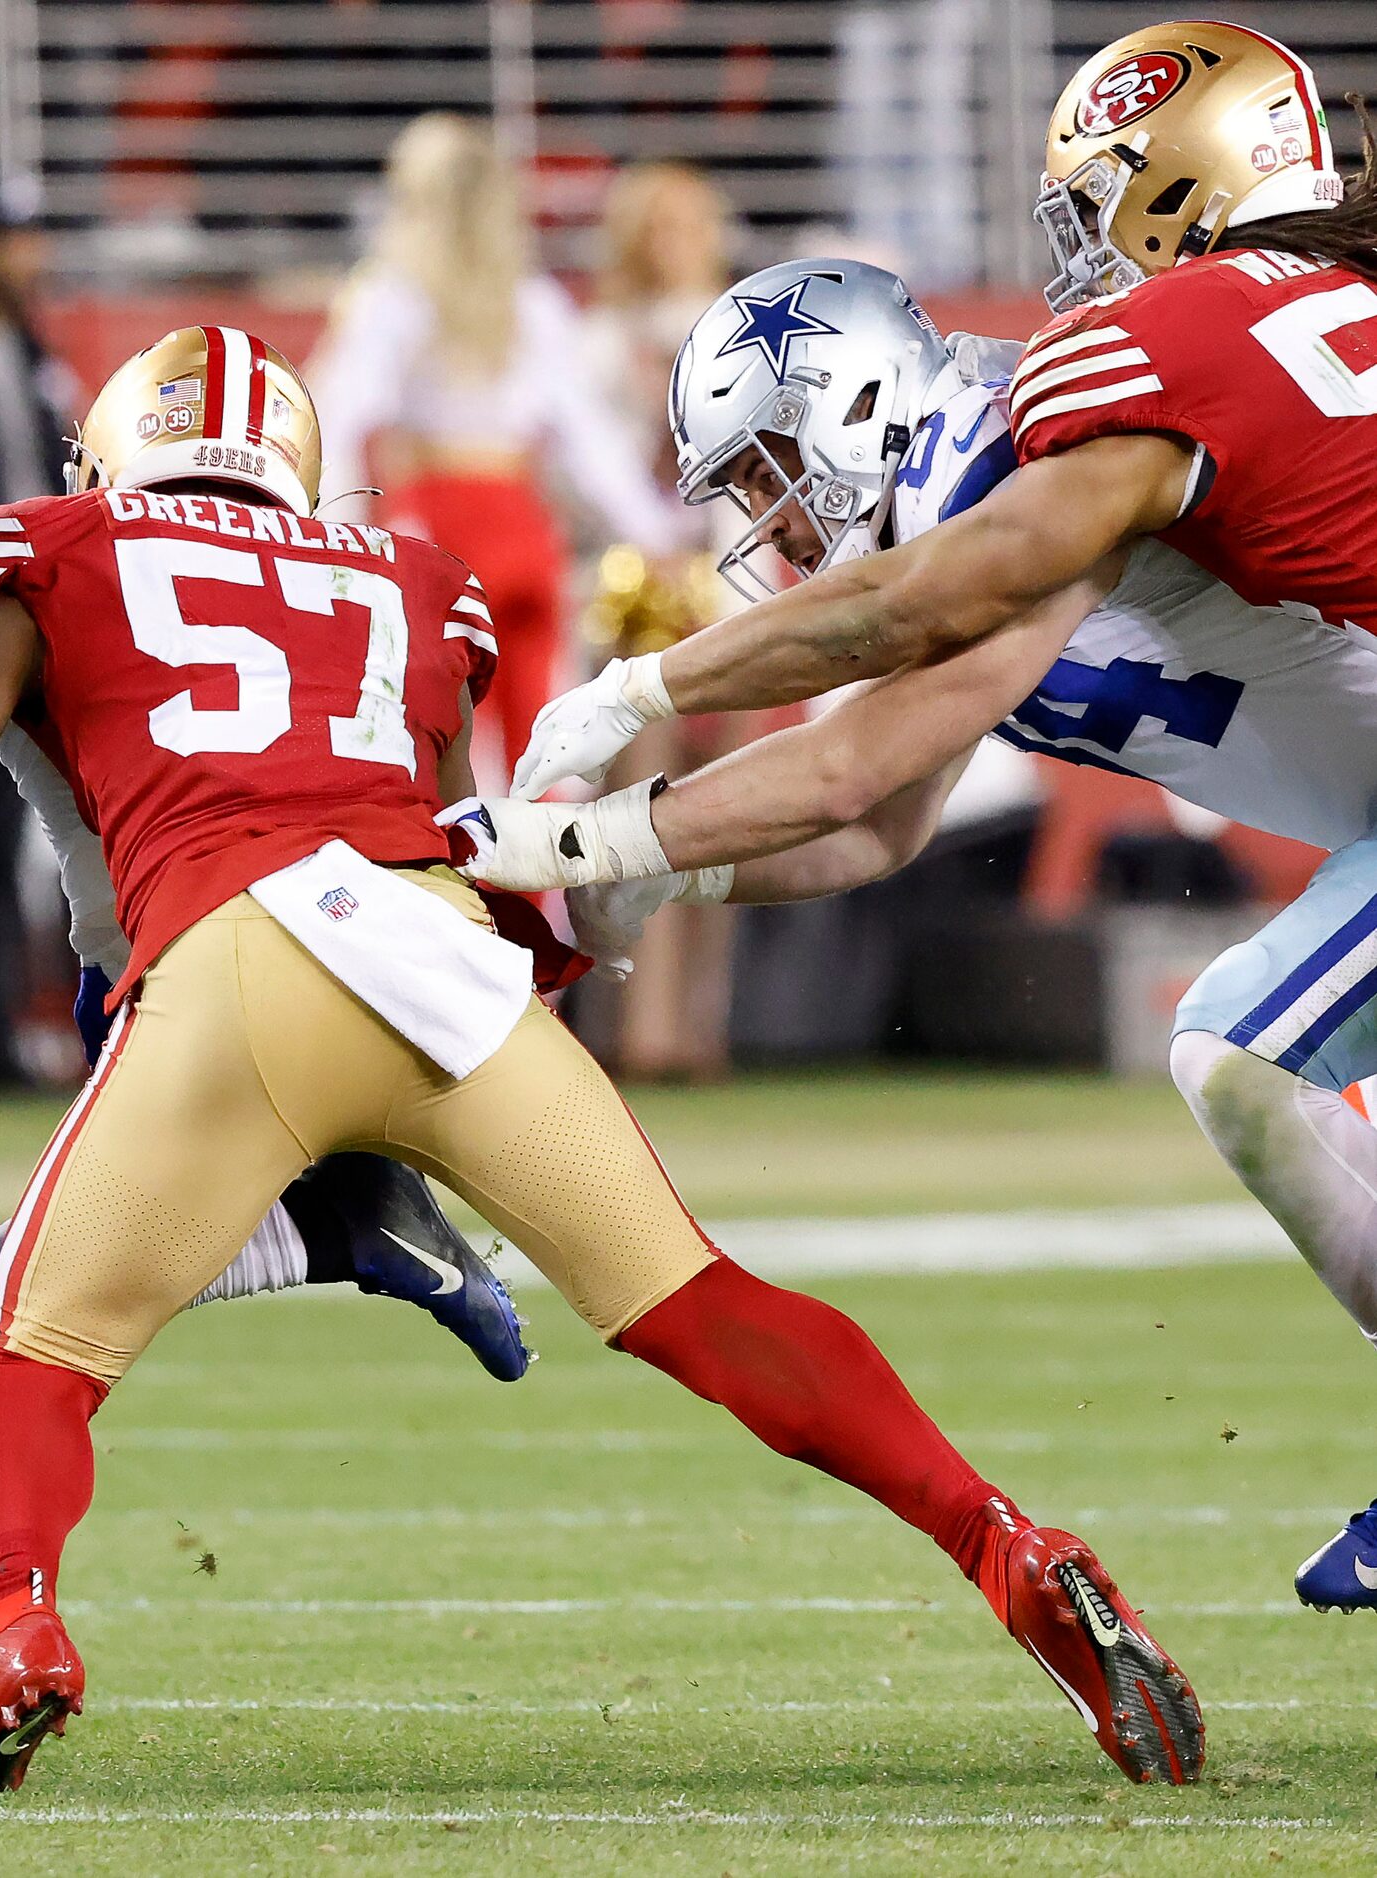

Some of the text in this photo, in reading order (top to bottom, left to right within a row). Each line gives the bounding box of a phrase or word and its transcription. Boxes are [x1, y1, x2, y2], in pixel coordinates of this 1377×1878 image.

[1252, 149, 1274, 168] JM
[1283, 141, 1302, 160] 39
[137, 412, 160, 437] JM
[167, 409, 191, 428] 39
[193, 445, 267, 477] 49ERS
[104, 487, 397, 564] GREENLAW
[113, 536, 418, 783] 57
[327, 898, 357, 919] NFL
